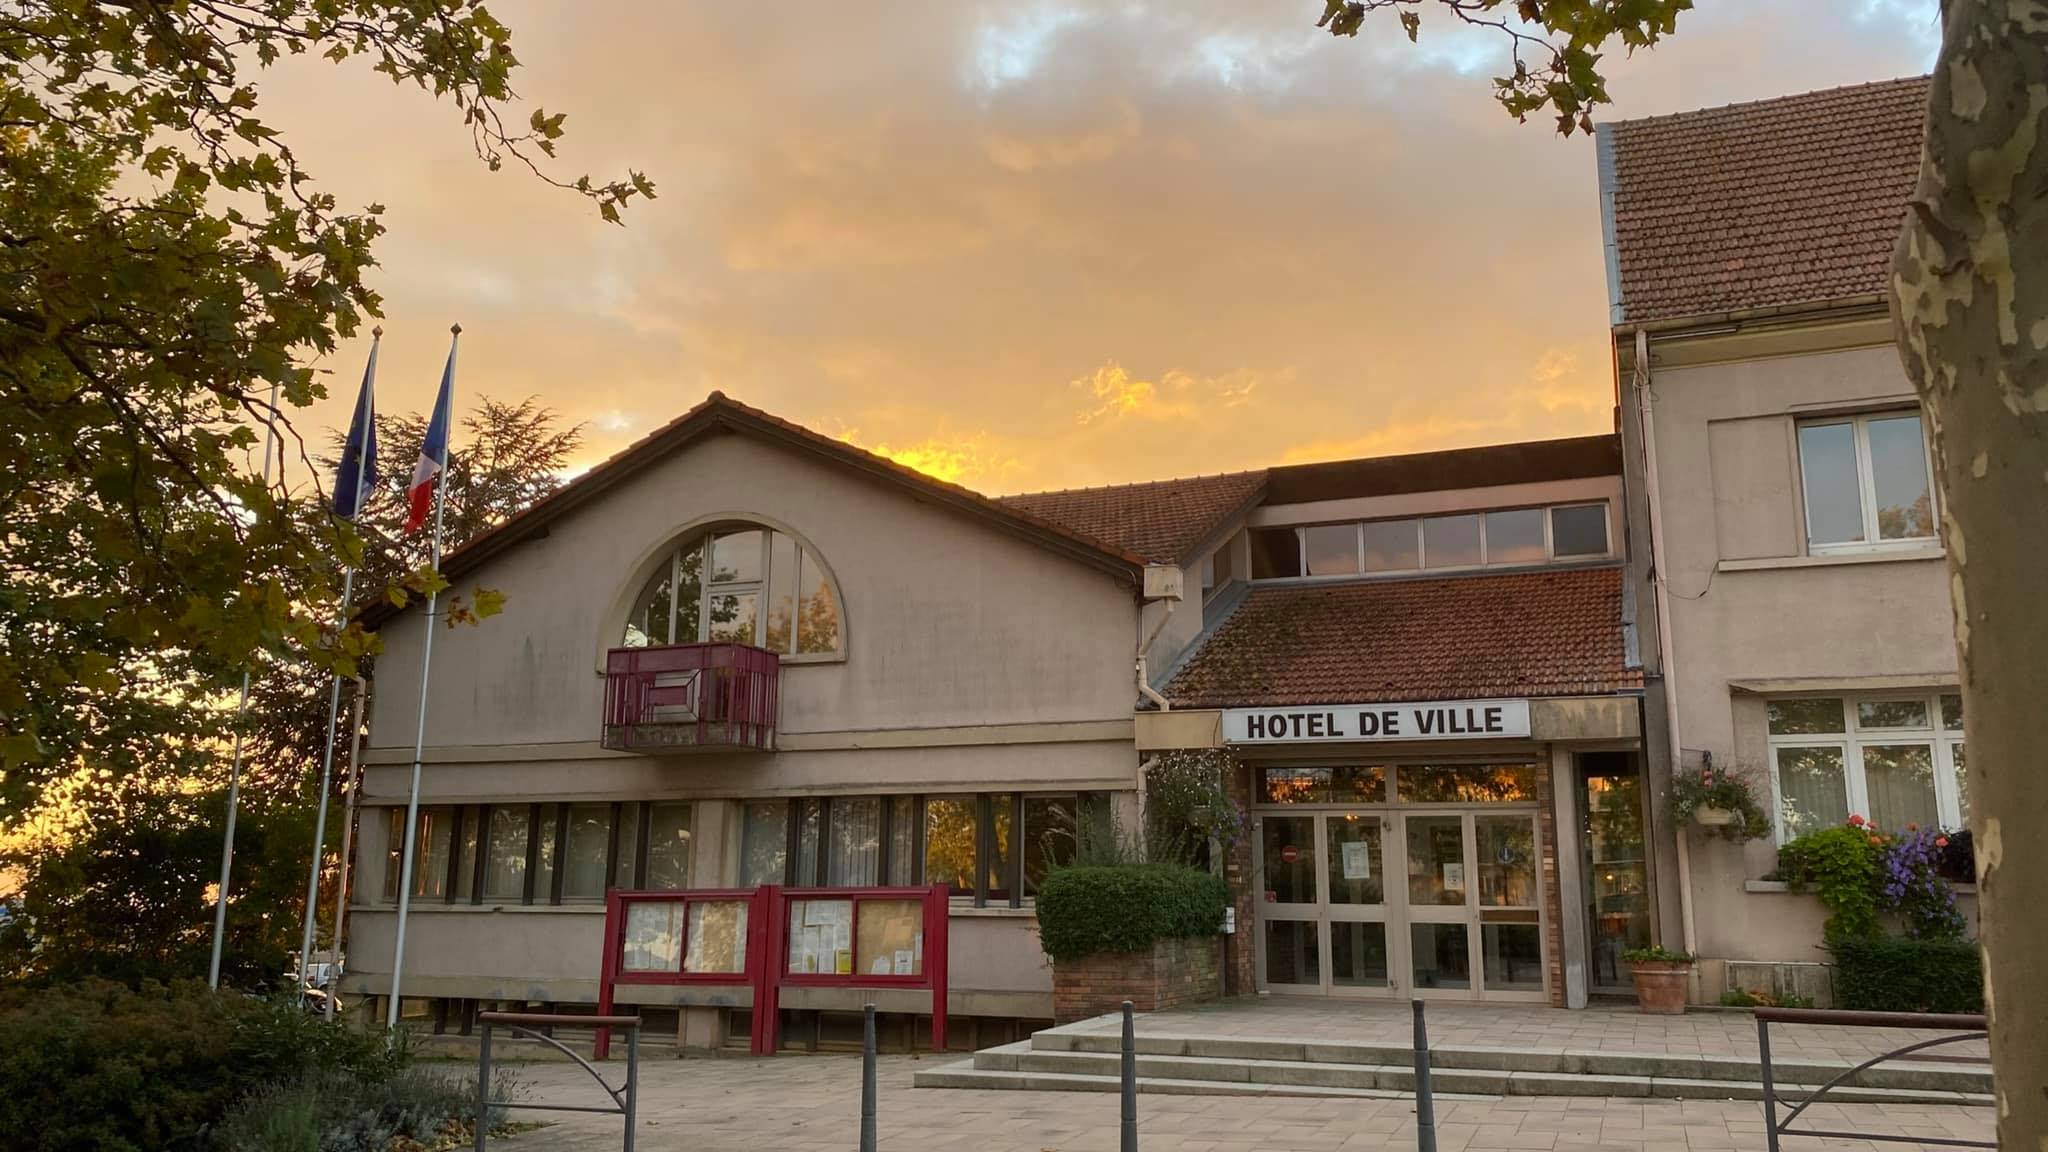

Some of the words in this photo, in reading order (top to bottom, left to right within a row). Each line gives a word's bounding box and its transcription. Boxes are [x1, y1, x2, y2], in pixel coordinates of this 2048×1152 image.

[1248, 712, 1344, 739] HOTEL
[1359, 711, 1400, 736] DE
[1414, 707, 1504, 734] VILLE
